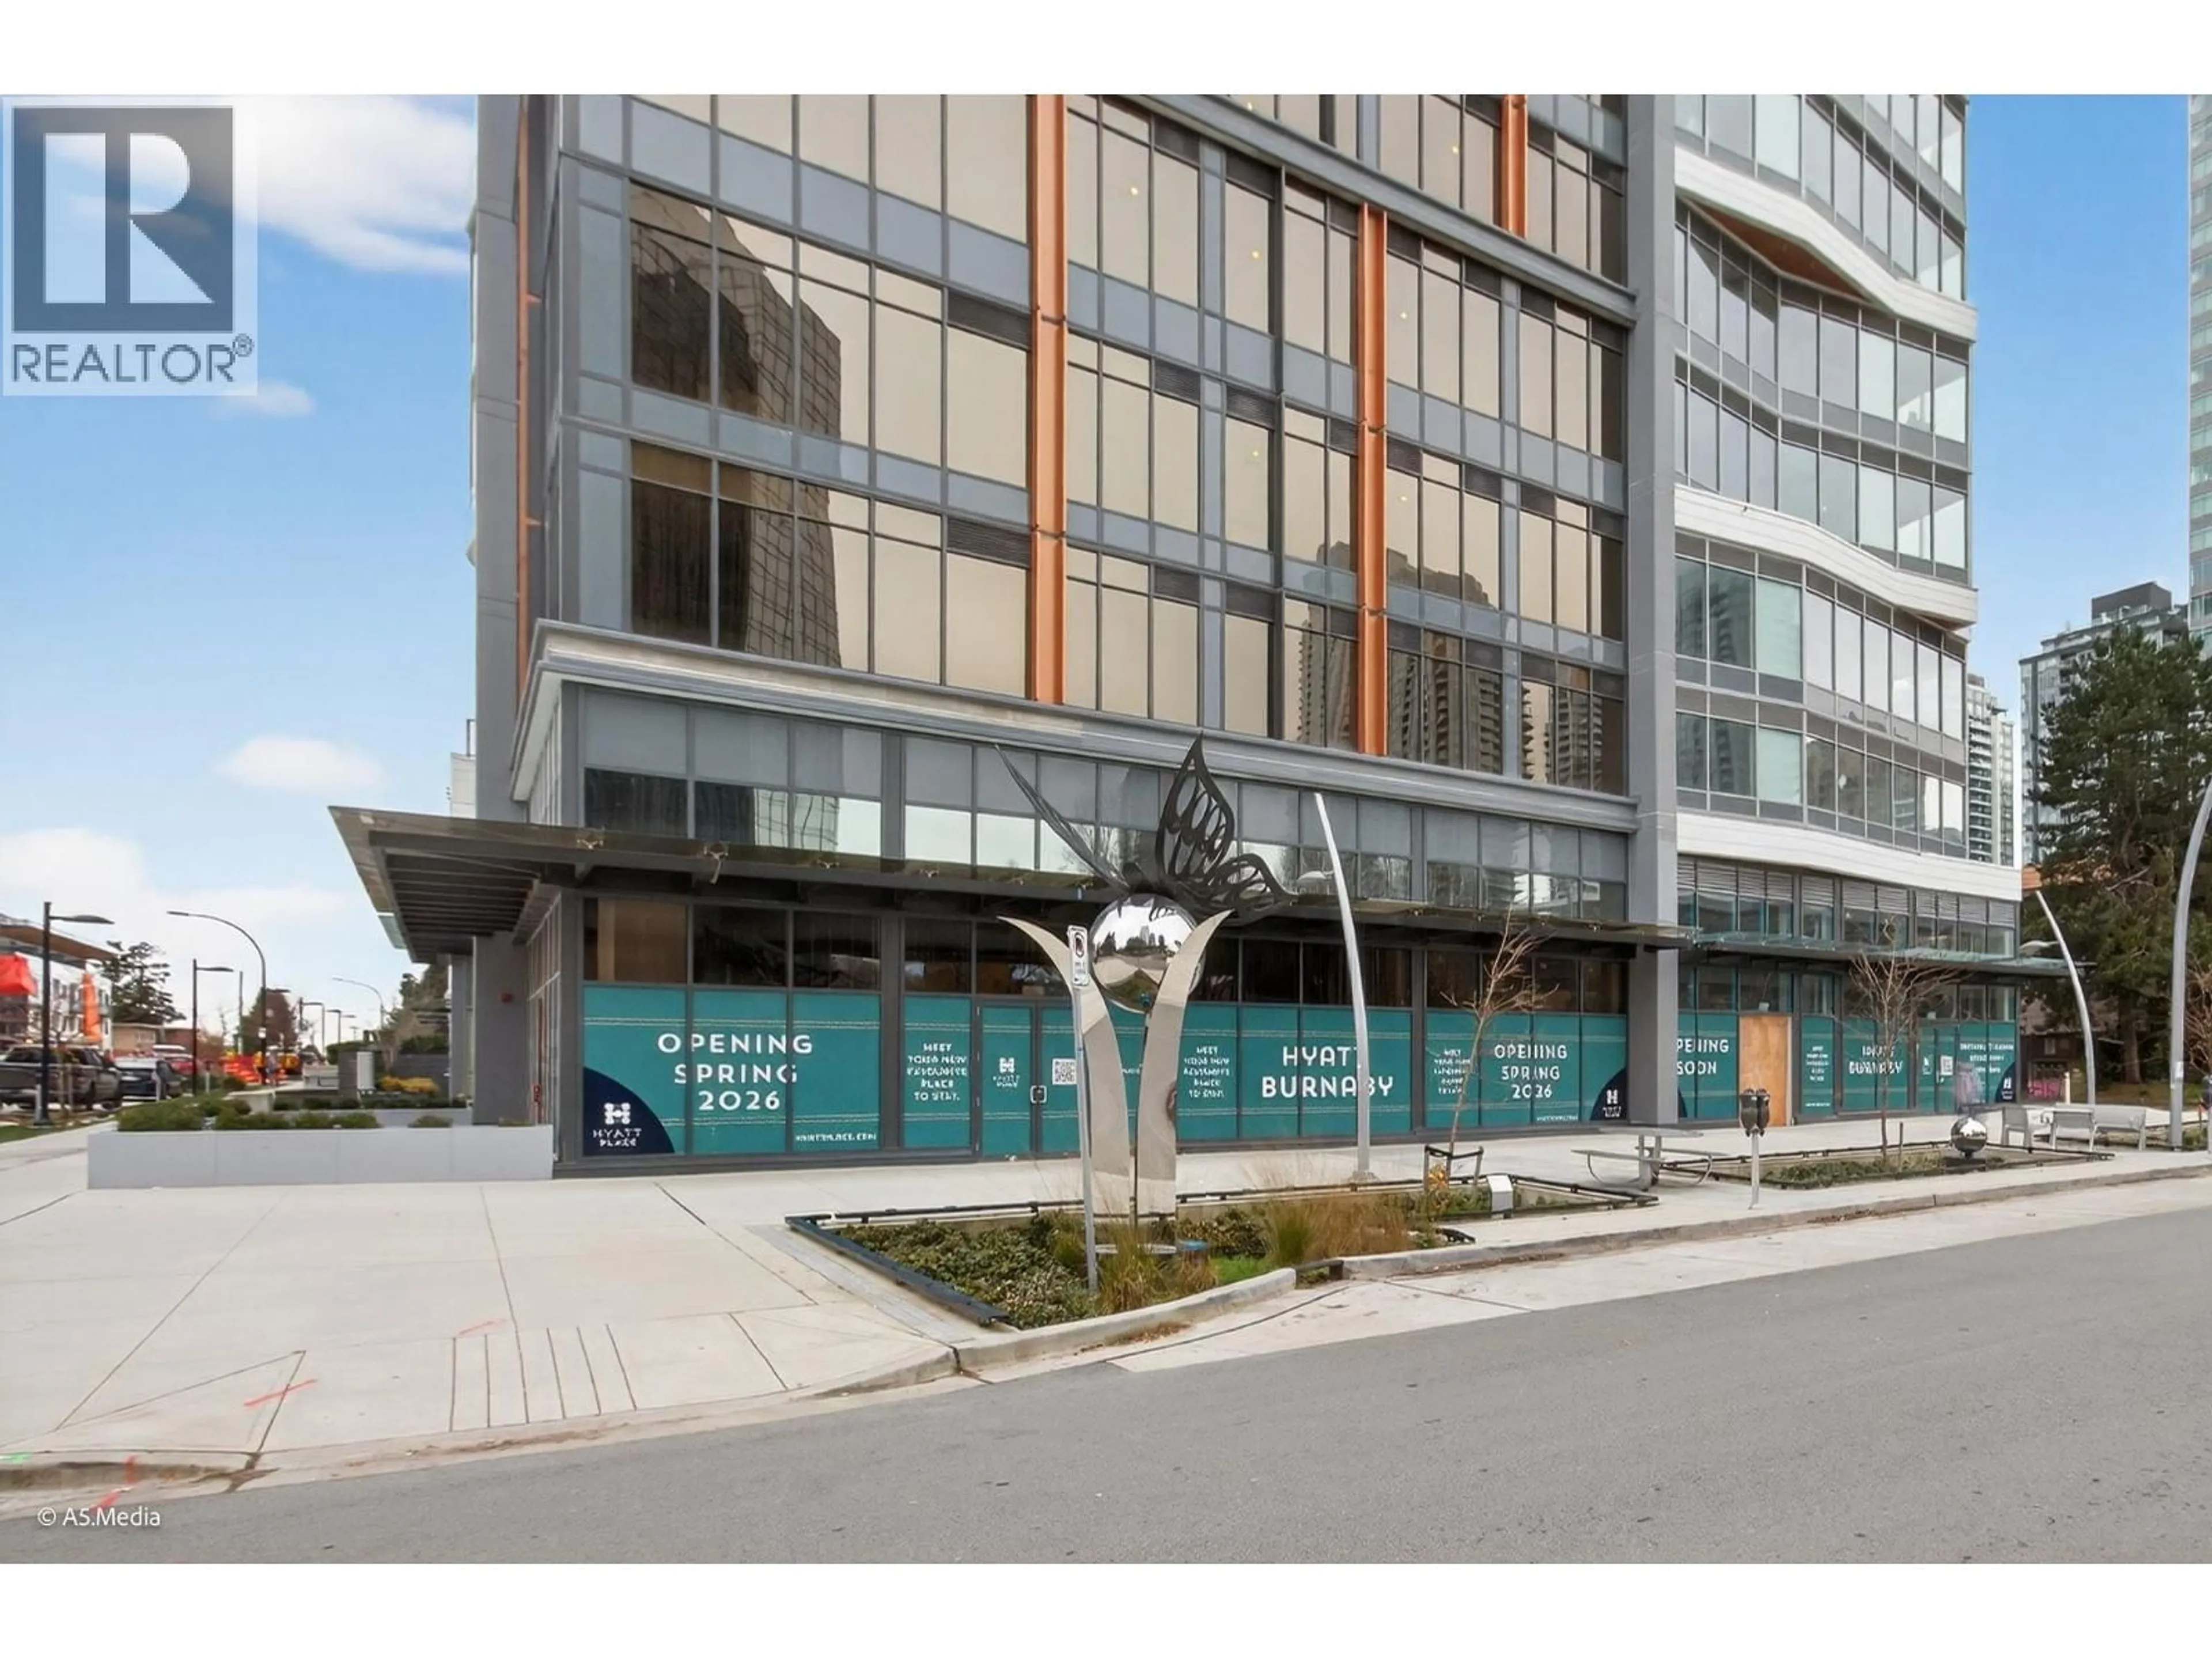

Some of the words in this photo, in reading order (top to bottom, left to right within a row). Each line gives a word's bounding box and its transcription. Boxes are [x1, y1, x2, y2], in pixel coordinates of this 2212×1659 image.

[658, 1033, 813, 1054] OPENING
[1494, 1043, 1567, 1059] OPENING
[1677, 1038, 1729, 1053] PENING
[1283, 1046, 1358, 1066] HYAT
[674, 1064, 797, 1084] SPRING
[1501, 1065, 1560, 1081] SPRING
[1676, 1060, 1717, 1075] SOON
[914, 1091, 929, 1101] TO
[1511, 1083, 1552, 1099] 2026
[698, 1090, 780, 1111] 2026
[593, 1128, 642, 1138] HYATT
